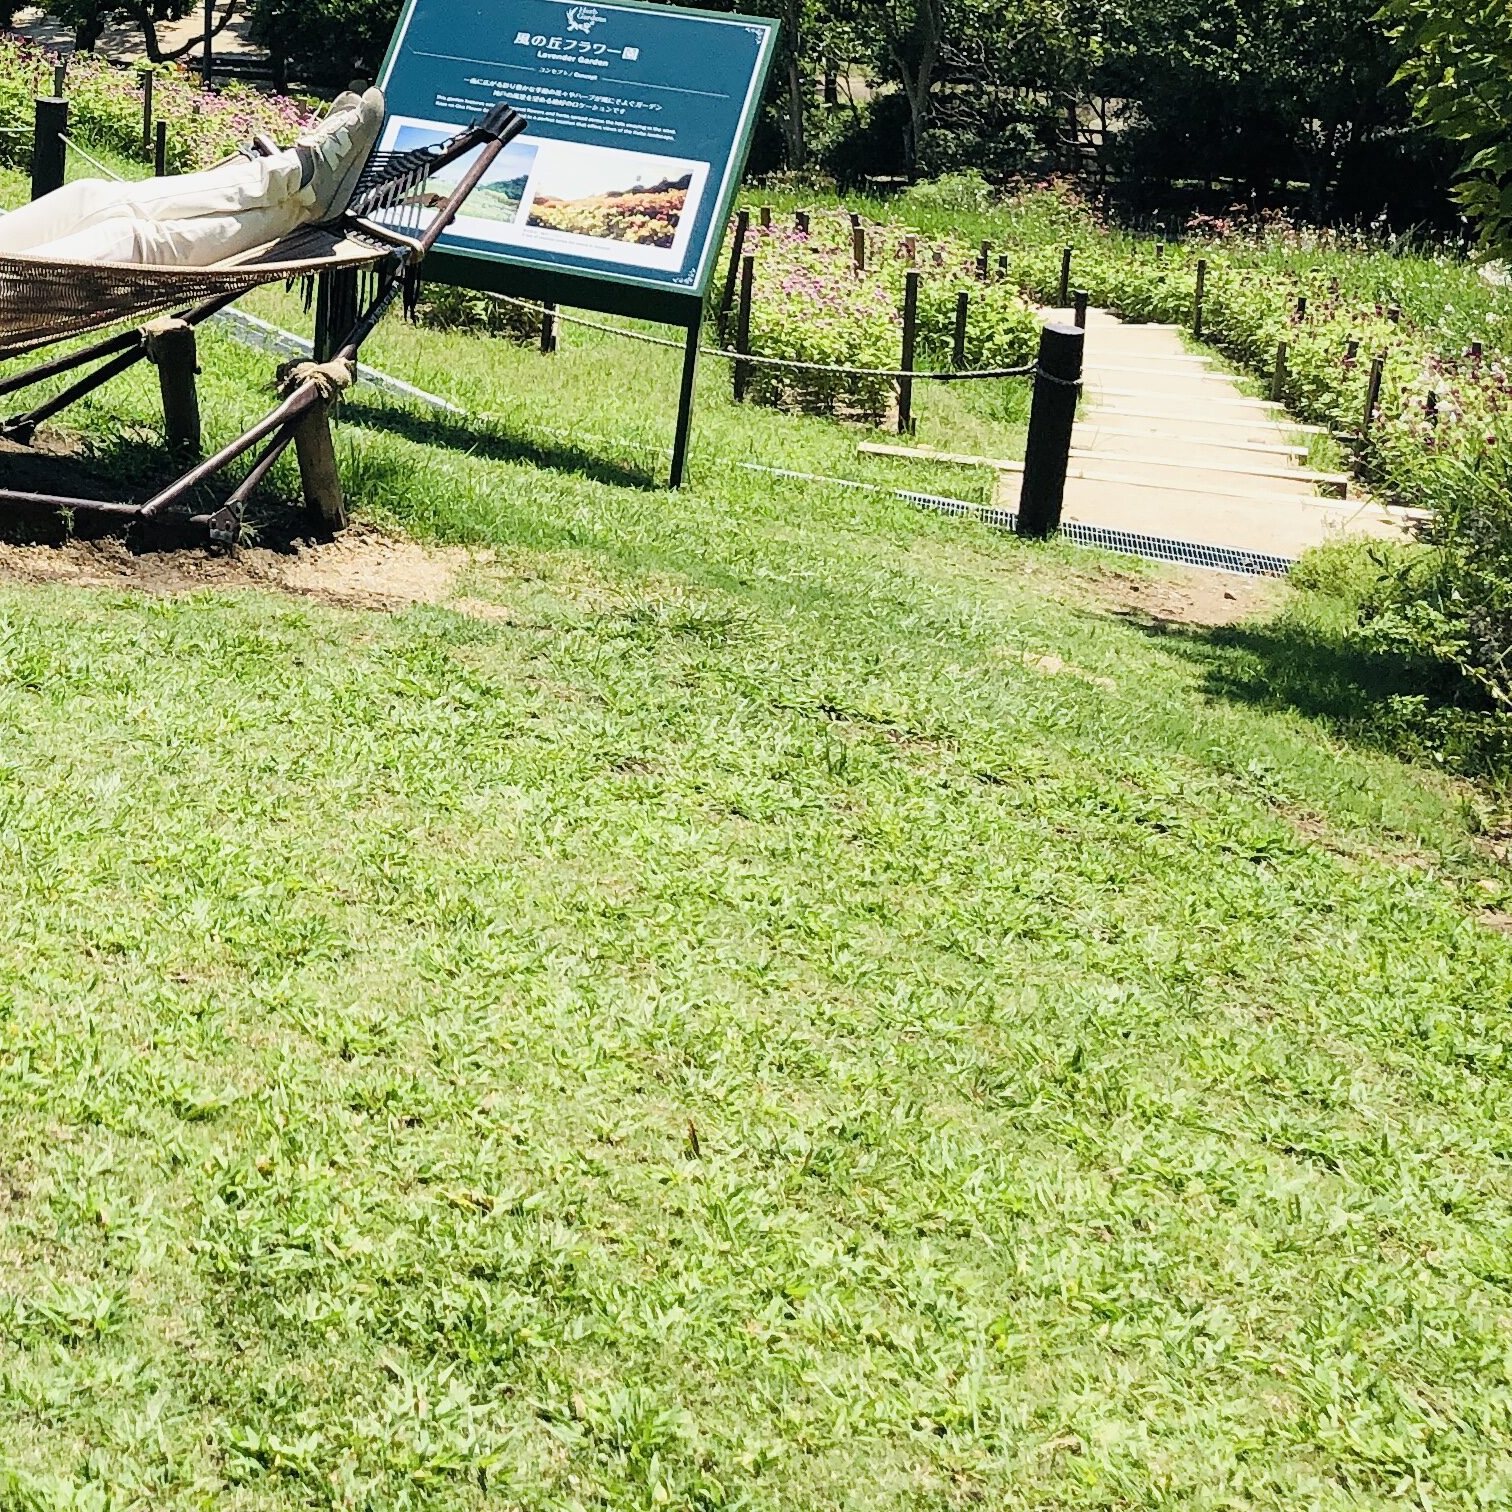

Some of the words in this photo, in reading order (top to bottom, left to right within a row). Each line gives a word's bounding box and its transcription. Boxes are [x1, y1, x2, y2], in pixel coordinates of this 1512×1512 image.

[513, 32, 640, 61] 風の丘フラワー園
[578, 56, 609, 67] Garden
